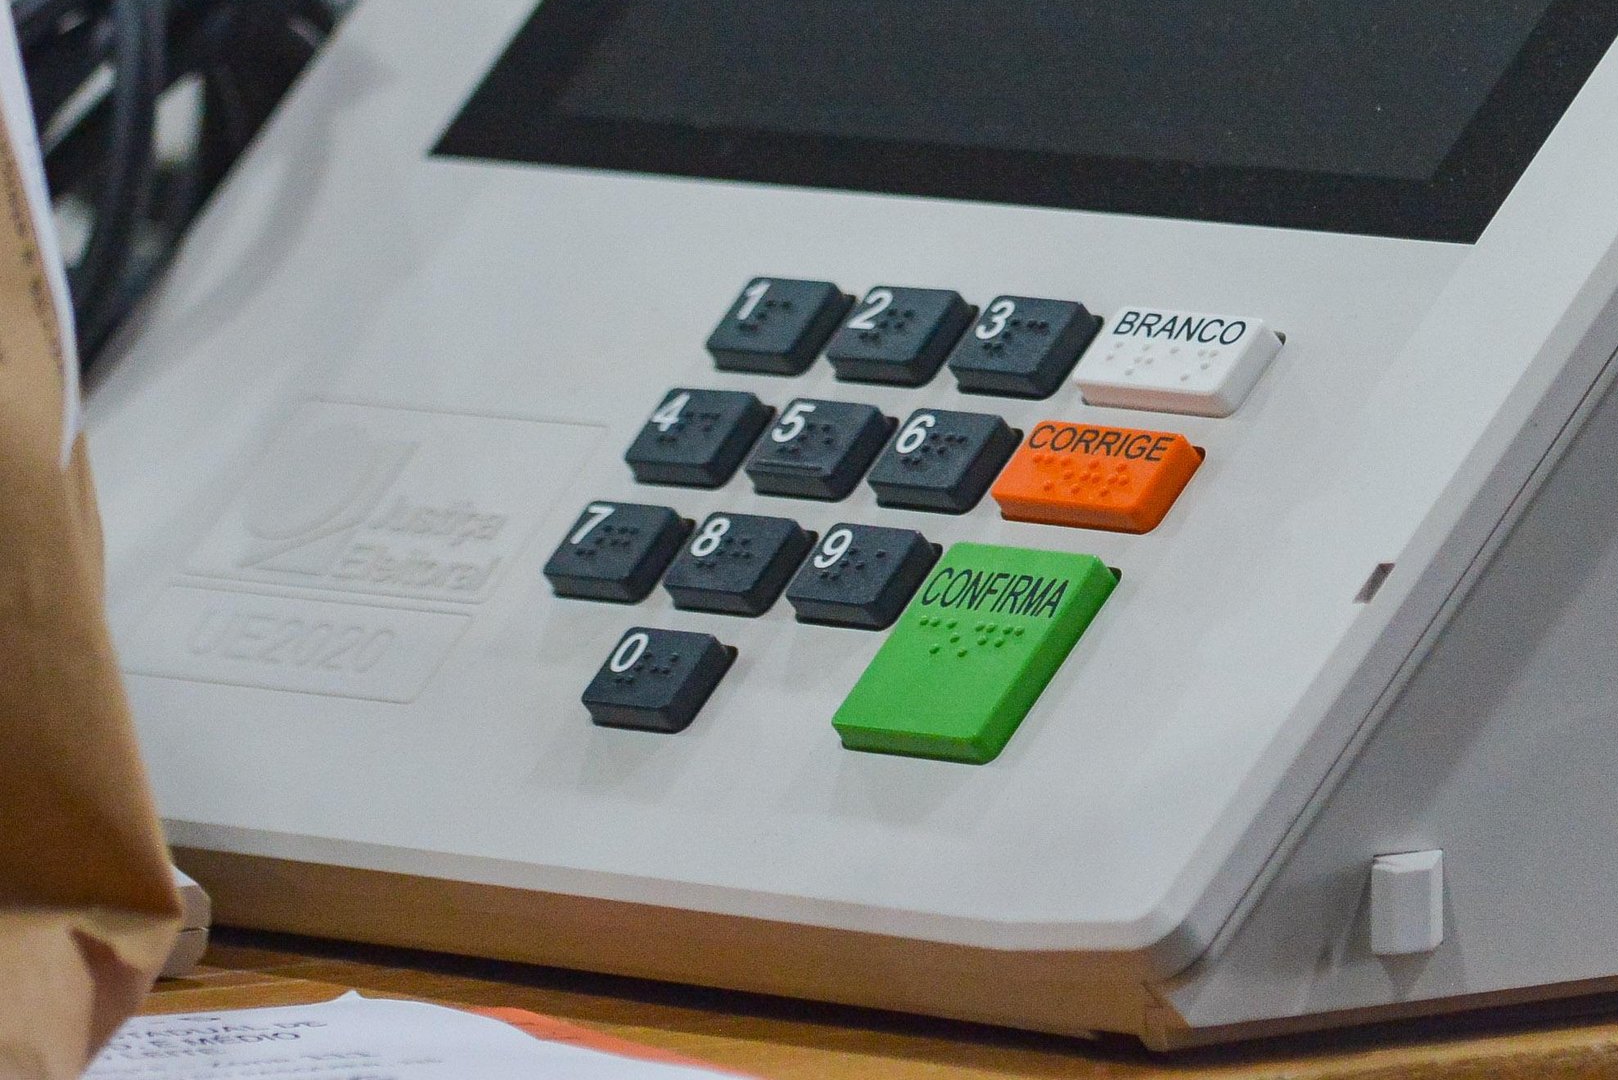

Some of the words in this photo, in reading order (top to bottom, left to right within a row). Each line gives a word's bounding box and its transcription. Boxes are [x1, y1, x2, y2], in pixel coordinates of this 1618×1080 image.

[736, 283, 770, 319] 1
[846, 289, 891, 331] 2
[976, 296, 1017, 340] 3
[1112, 311, 1248, 346] BRANCO
[651, 392, 680, 432] 4
[770, 402, 815, 442] 5
[895, 415, 927, 455] 6
[1027, 423, 1176, 462] CORRIGE
[568, 505, 605, 543] 7
[690, 516, 724, 558] 8
[813, 527, 853, 569] 9
[920, 567, 1070, 618] CONFIRMA
[187, 607, 398, 675] UE2020
[609, 633, 646, 673] 0
